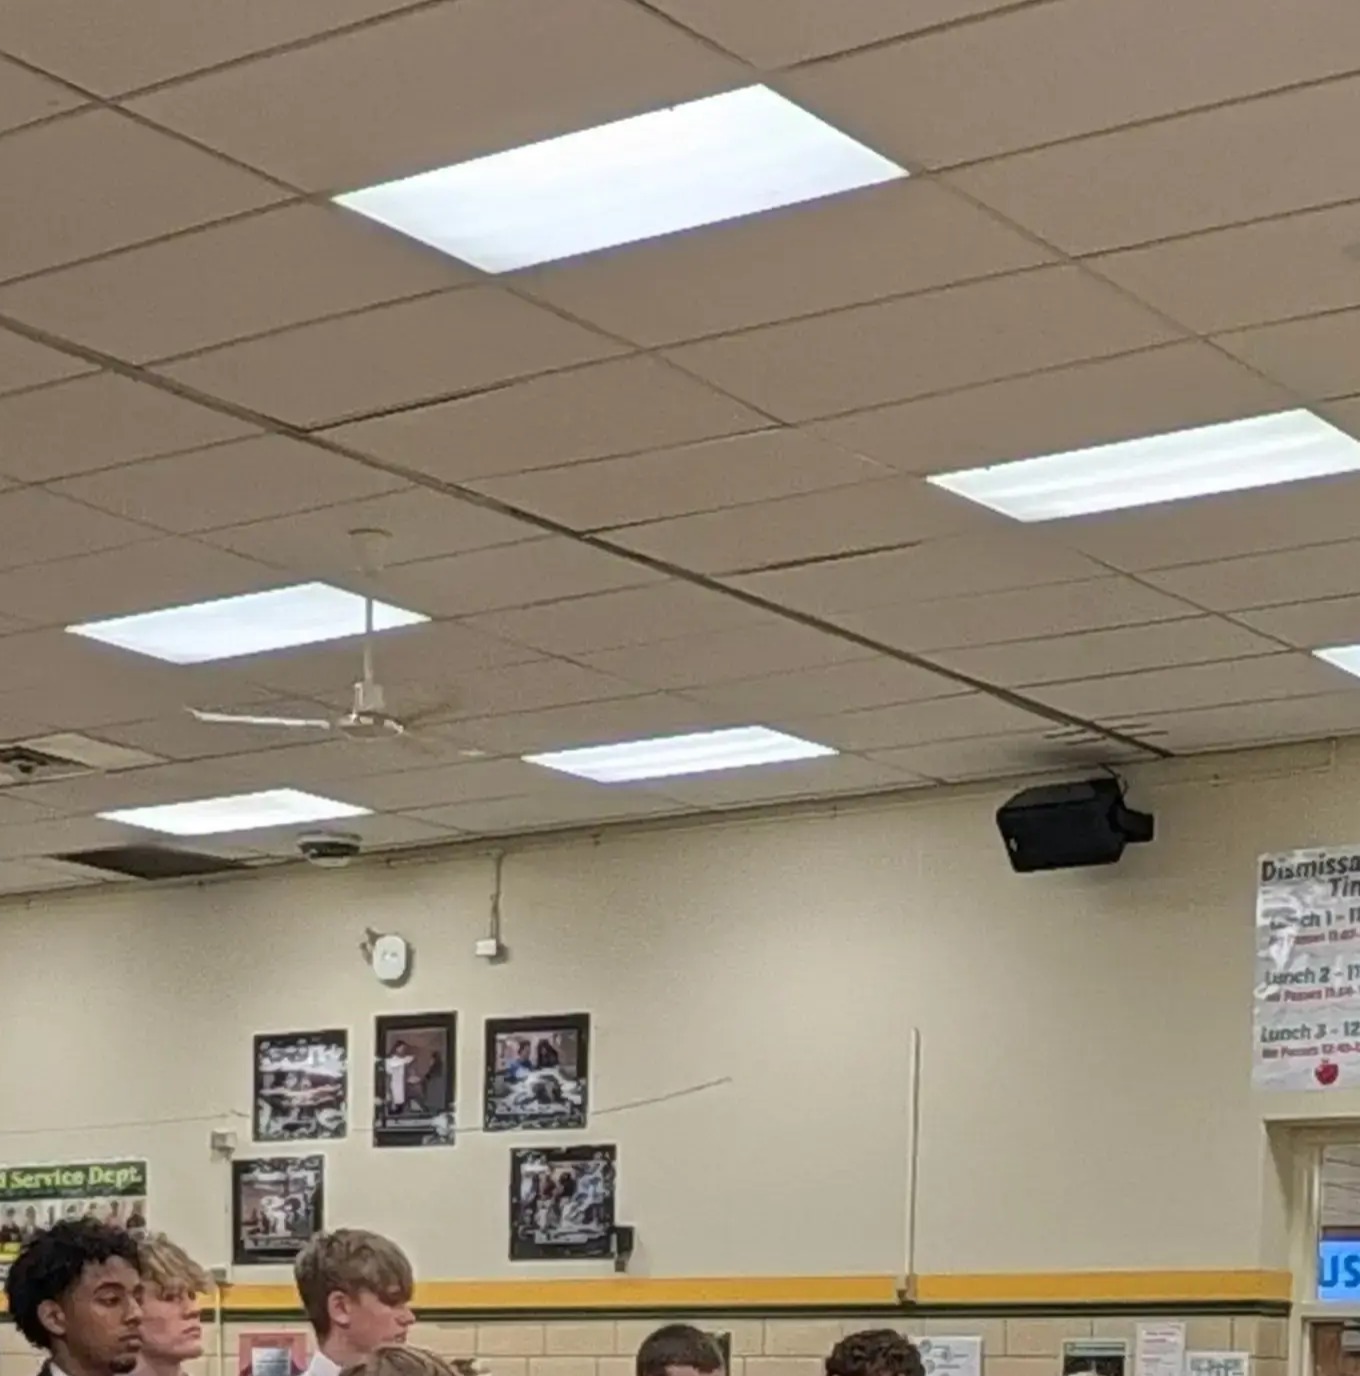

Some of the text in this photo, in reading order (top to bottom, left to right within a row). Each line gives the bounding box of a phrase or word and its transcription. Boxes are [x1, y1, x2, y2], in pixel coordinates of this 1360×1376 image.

[1265, 968, 1315, 985] Lunch
[1319, 967, 1330, 983] 2
[1261, 1023, 1311, 1042] Lunch
[1314, 1024, 1327, 1039] 3
[10, 1169, 85, 1189] Service
[88, 1165, 142, 1187] Dept.
